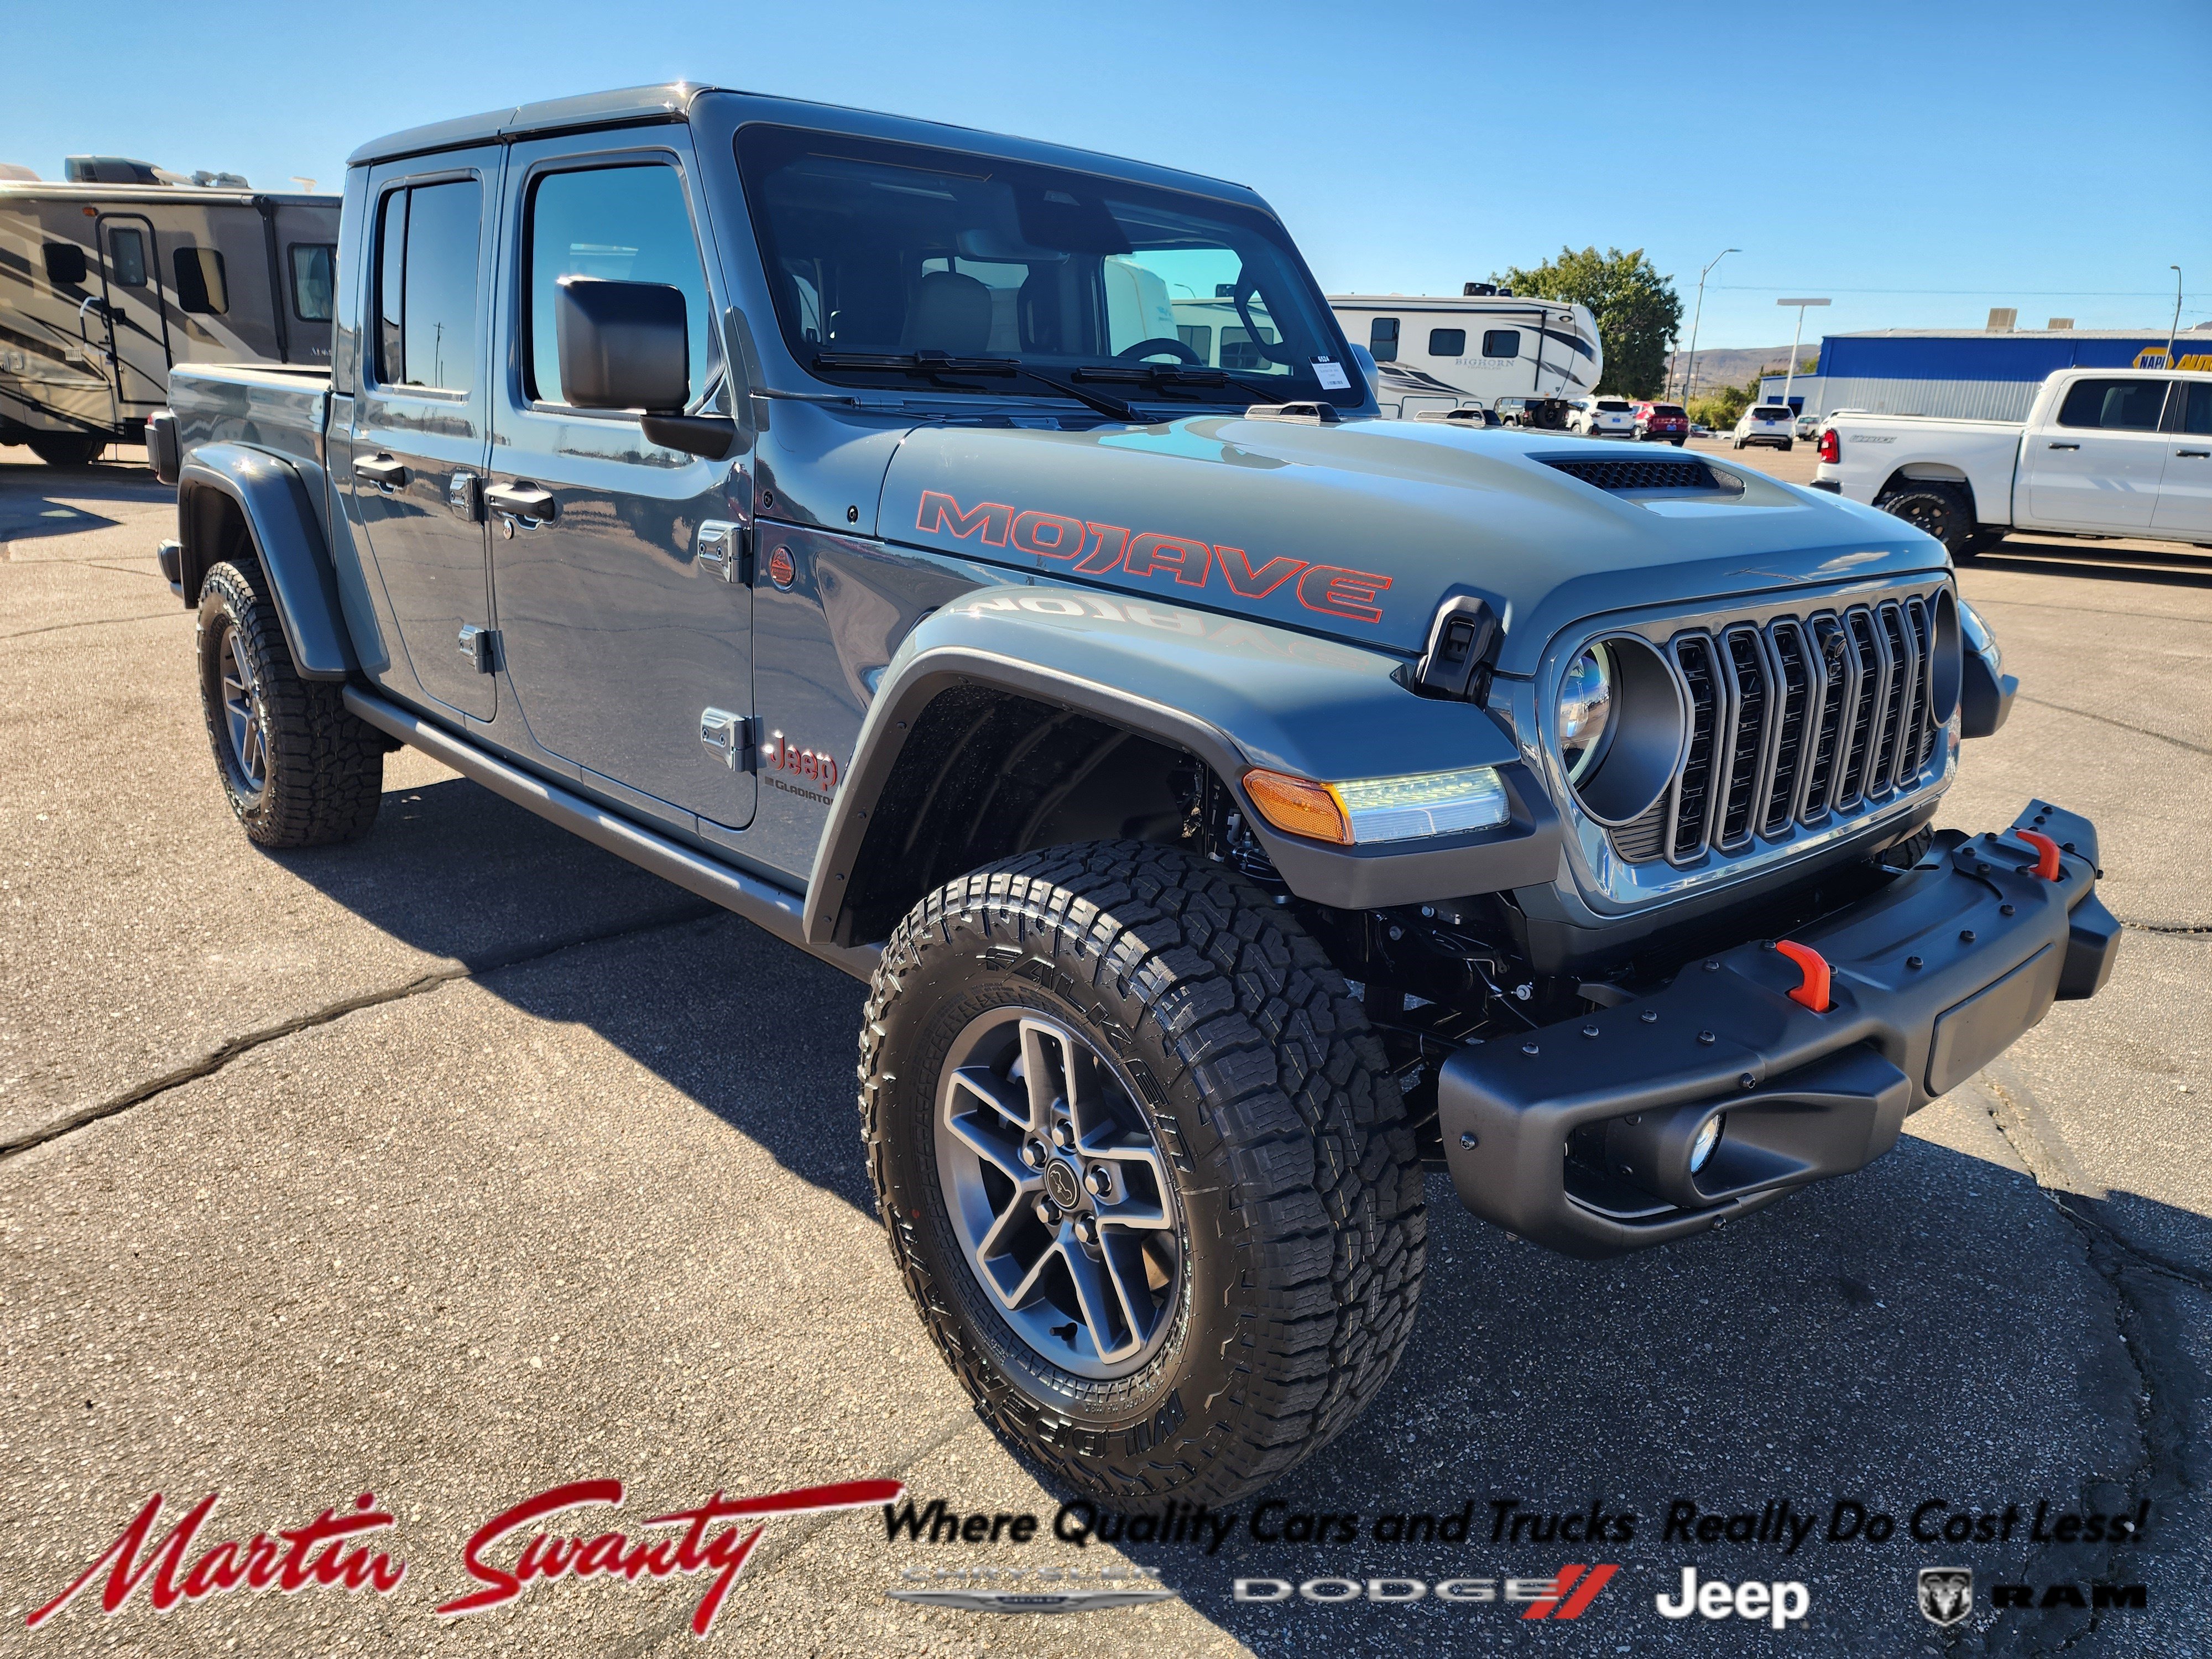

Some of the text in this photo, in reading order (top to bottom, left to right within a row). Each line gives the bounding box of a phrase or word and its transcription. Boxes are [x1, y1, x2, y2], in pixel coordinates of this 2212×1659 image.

[1455, 358, 1515, 367] BIGHORN
[2175, 354, 2212, 372] AUT
[915, 490, 1393, 623] MOJAVE
[763, 729, 837, 791] Jeep
[775, 780, 834, 806] GLADIATO
